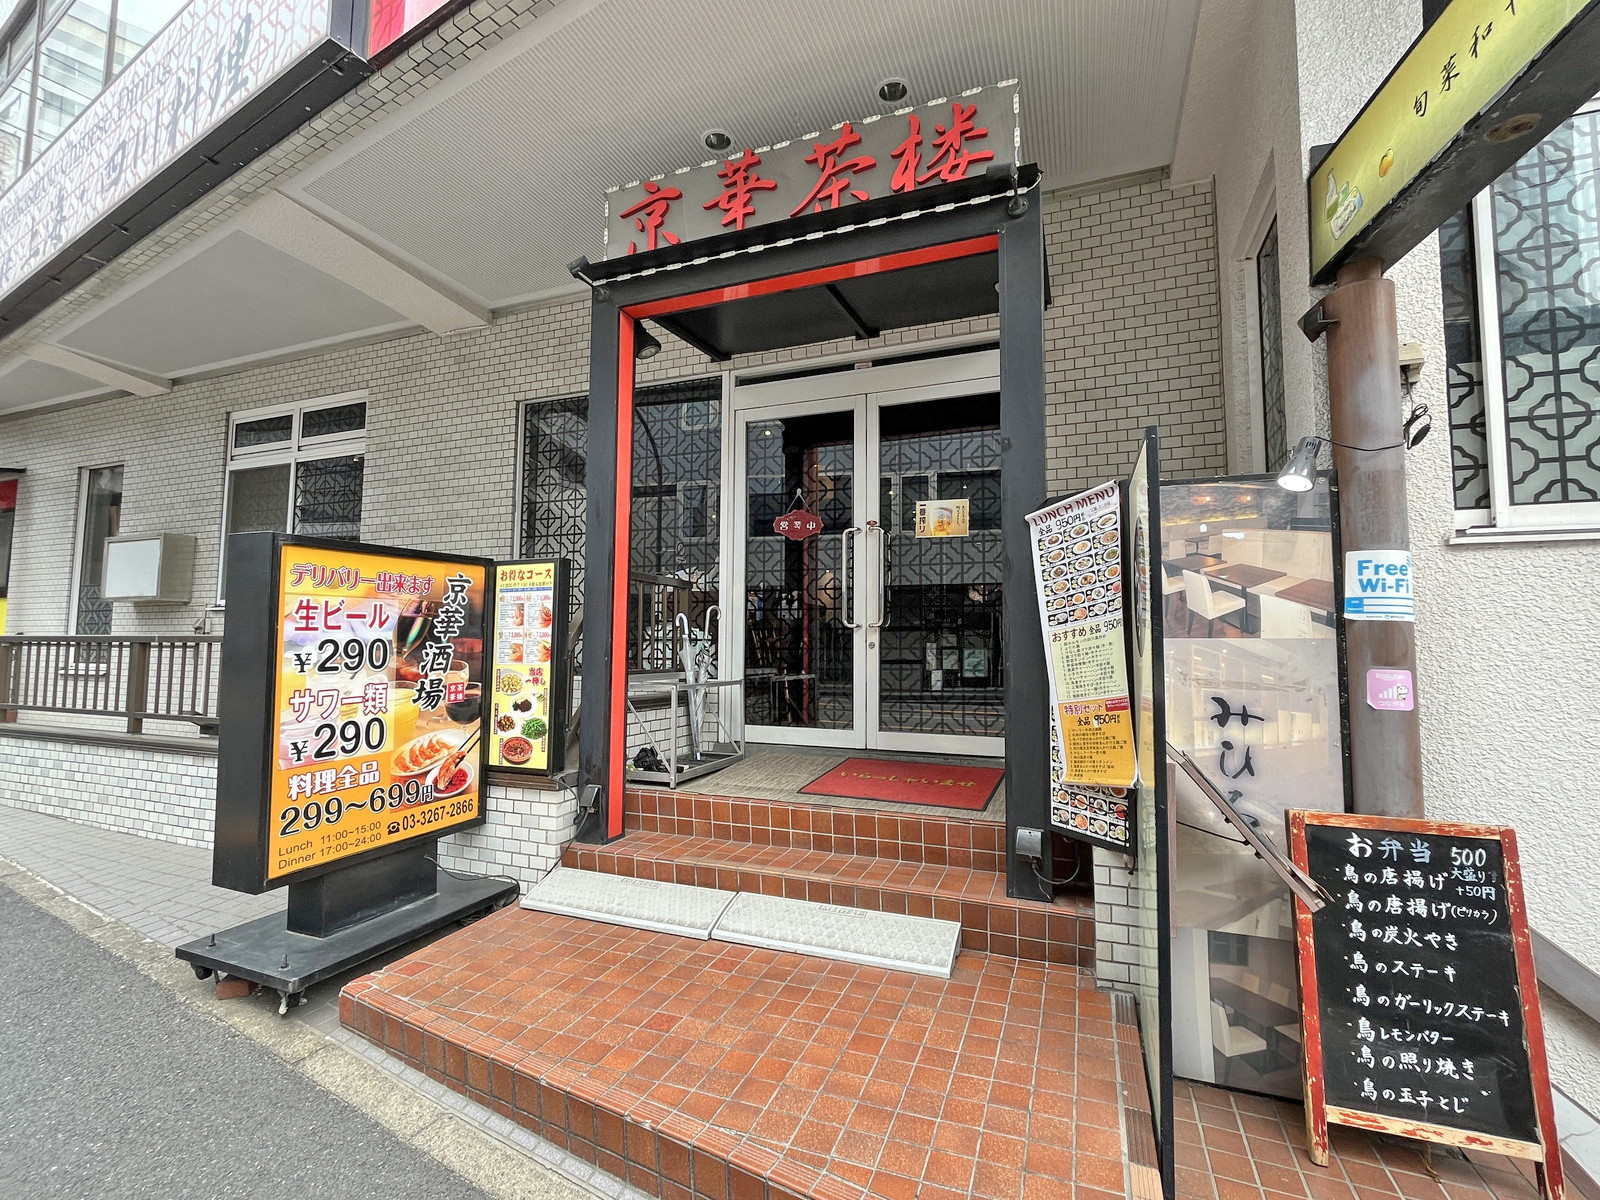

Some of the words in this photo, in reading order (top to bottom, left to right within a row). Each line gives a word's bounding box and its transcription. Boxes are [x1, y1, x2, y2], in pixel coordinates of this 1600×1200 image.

[1413, 0, 1516, 117] 旬菜和
[619, 103, 994, 255] 京華茶楼
[1032, 503, 1074, 527] LUNCH
[1076, 486, 1116, 510] MENU
[290, 563, 435, 595] デリバリー出来ます
[500, 568, 552, 582] お得なコース
[1357, 559, 1408, 577] Free
[1358, 578, 1409, 594] Wi-Fi
[293, 598, 390, 633] 生ビール
[412, 573, 472, 712] 京華酒場
[1052, 626, 1087, 643] おすすめ
[1089, 623, 1101, 635] 全品
[294, 638, 389, 674] ¥290
[289, 682, 388, 723] サワー類
[1064, 703, 1103, 716] 特別セット
[1077, 716, 1091, 727] 全品
[1093, 713, 1117, 726] 950円
[290, 716, 386, 763] ¥290
[287, 760, 381, 801] 料理全品
[402, 798, 474, 831] 03-3267-2866
[278, 839, 313, 857] Lunch
[278, 851, 316, 870] Dinner
[1345, 832, 1432, 864] お弁当
[1451, 848, 1487, 867] 500
[1343, 863, 1449, 892] 鳥の唐揚げ
[1350, 951, 1457, 983] 鳥のステーキ
[1352, 983, 1510, 1027] 鳥のガーリックステーキ
[1357, 1016, 1455, 1045] 鳥レモンバター
[1357, 1044, 1475, 1081] 鳥の照り焼き
[1360, 1077, 1470, 1114] 鳥の玉子とじ
